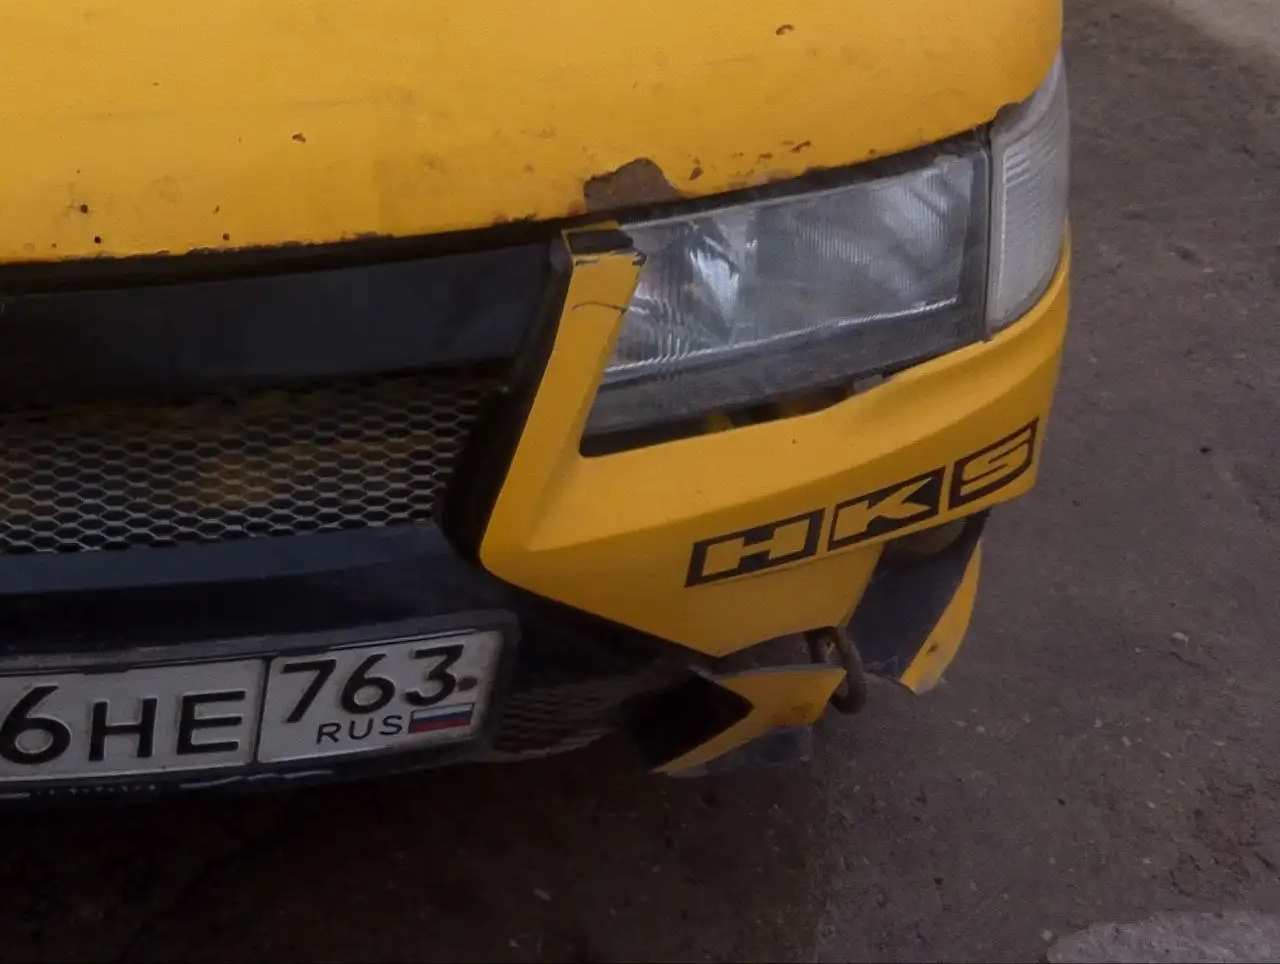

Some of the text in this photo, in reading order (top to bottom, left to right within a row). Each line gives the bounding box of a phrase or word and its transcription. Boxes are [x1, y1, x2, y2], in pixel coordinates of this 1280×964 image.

[684, 416, 1039, 587] HKS
[282, 644, 464, 724] 763
[316, 715, 403, 744] RUS
